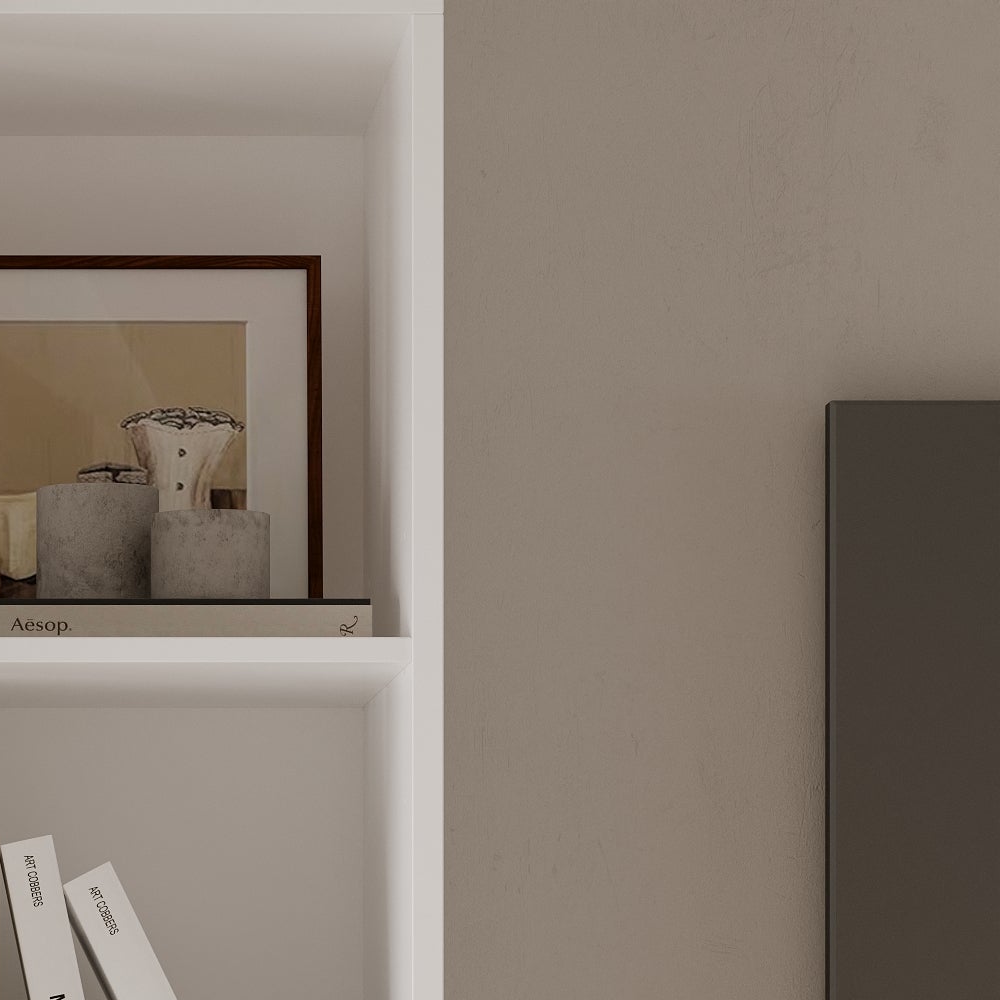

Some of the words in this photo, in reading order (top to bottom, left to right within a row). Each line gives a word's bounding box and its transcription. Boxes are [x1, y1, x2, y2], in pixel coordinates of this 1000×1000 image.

[23, 855, 37, 869] ART
[27, 871, 44, 908] COBBERS
[88, 886, 104, 901] ART
[96, 900, 120, 936] COBBERS
